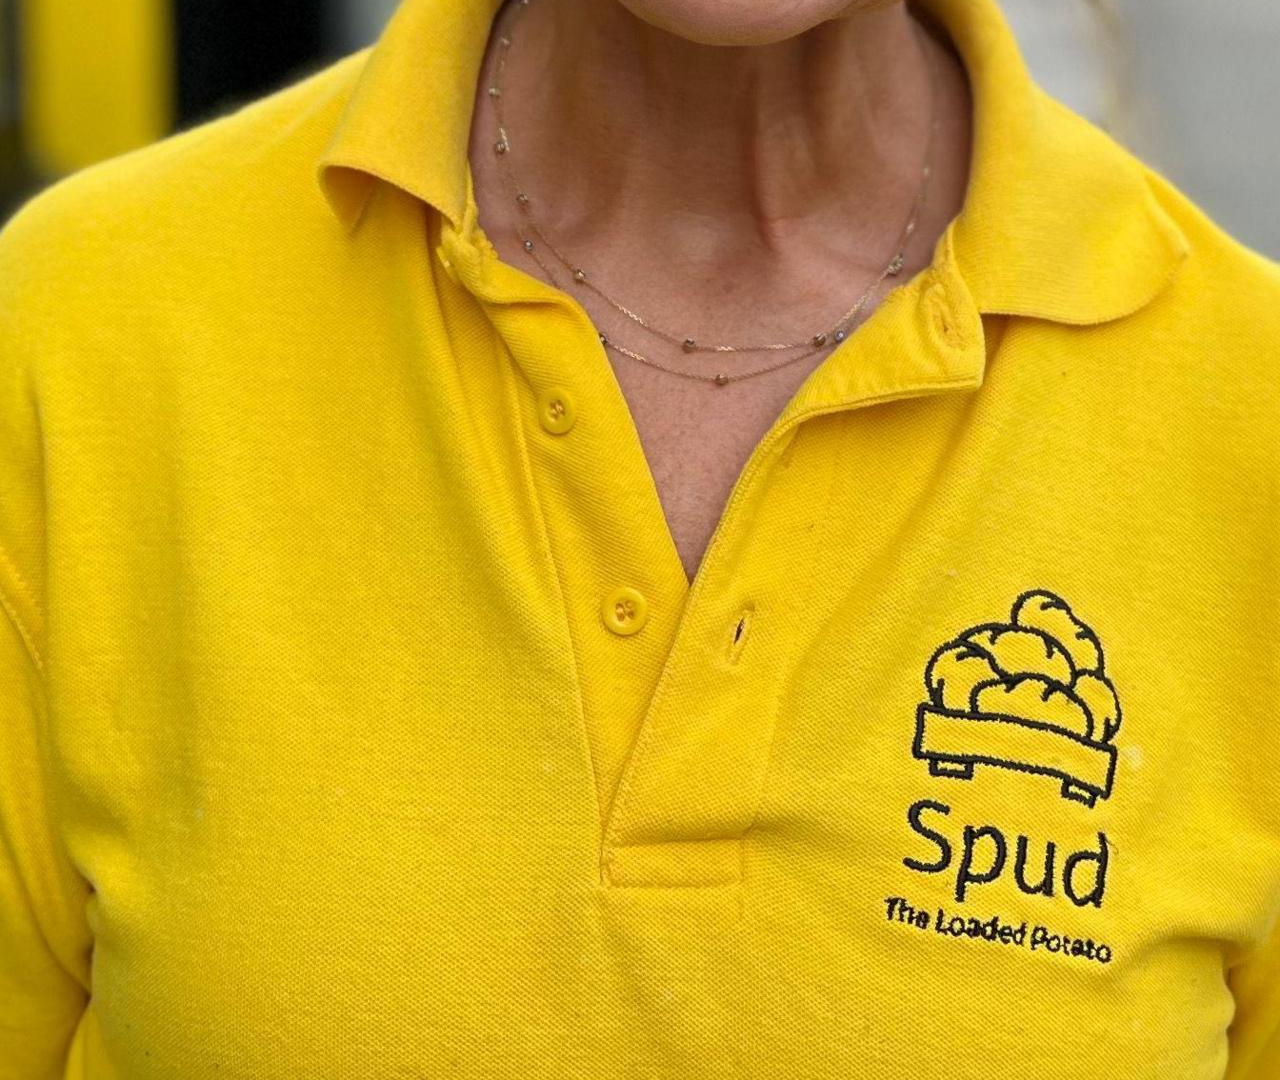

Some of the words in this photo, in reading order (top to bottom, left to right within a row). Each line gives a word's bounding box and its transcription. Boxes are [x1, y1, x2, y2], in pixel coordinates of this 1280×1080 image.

[902, 799, 1109, 909] Spud
[884, 897, 929, 930] The
[935, 909, 1027, 946] Loaded
[1030, 926, 1112, 964] Potato
